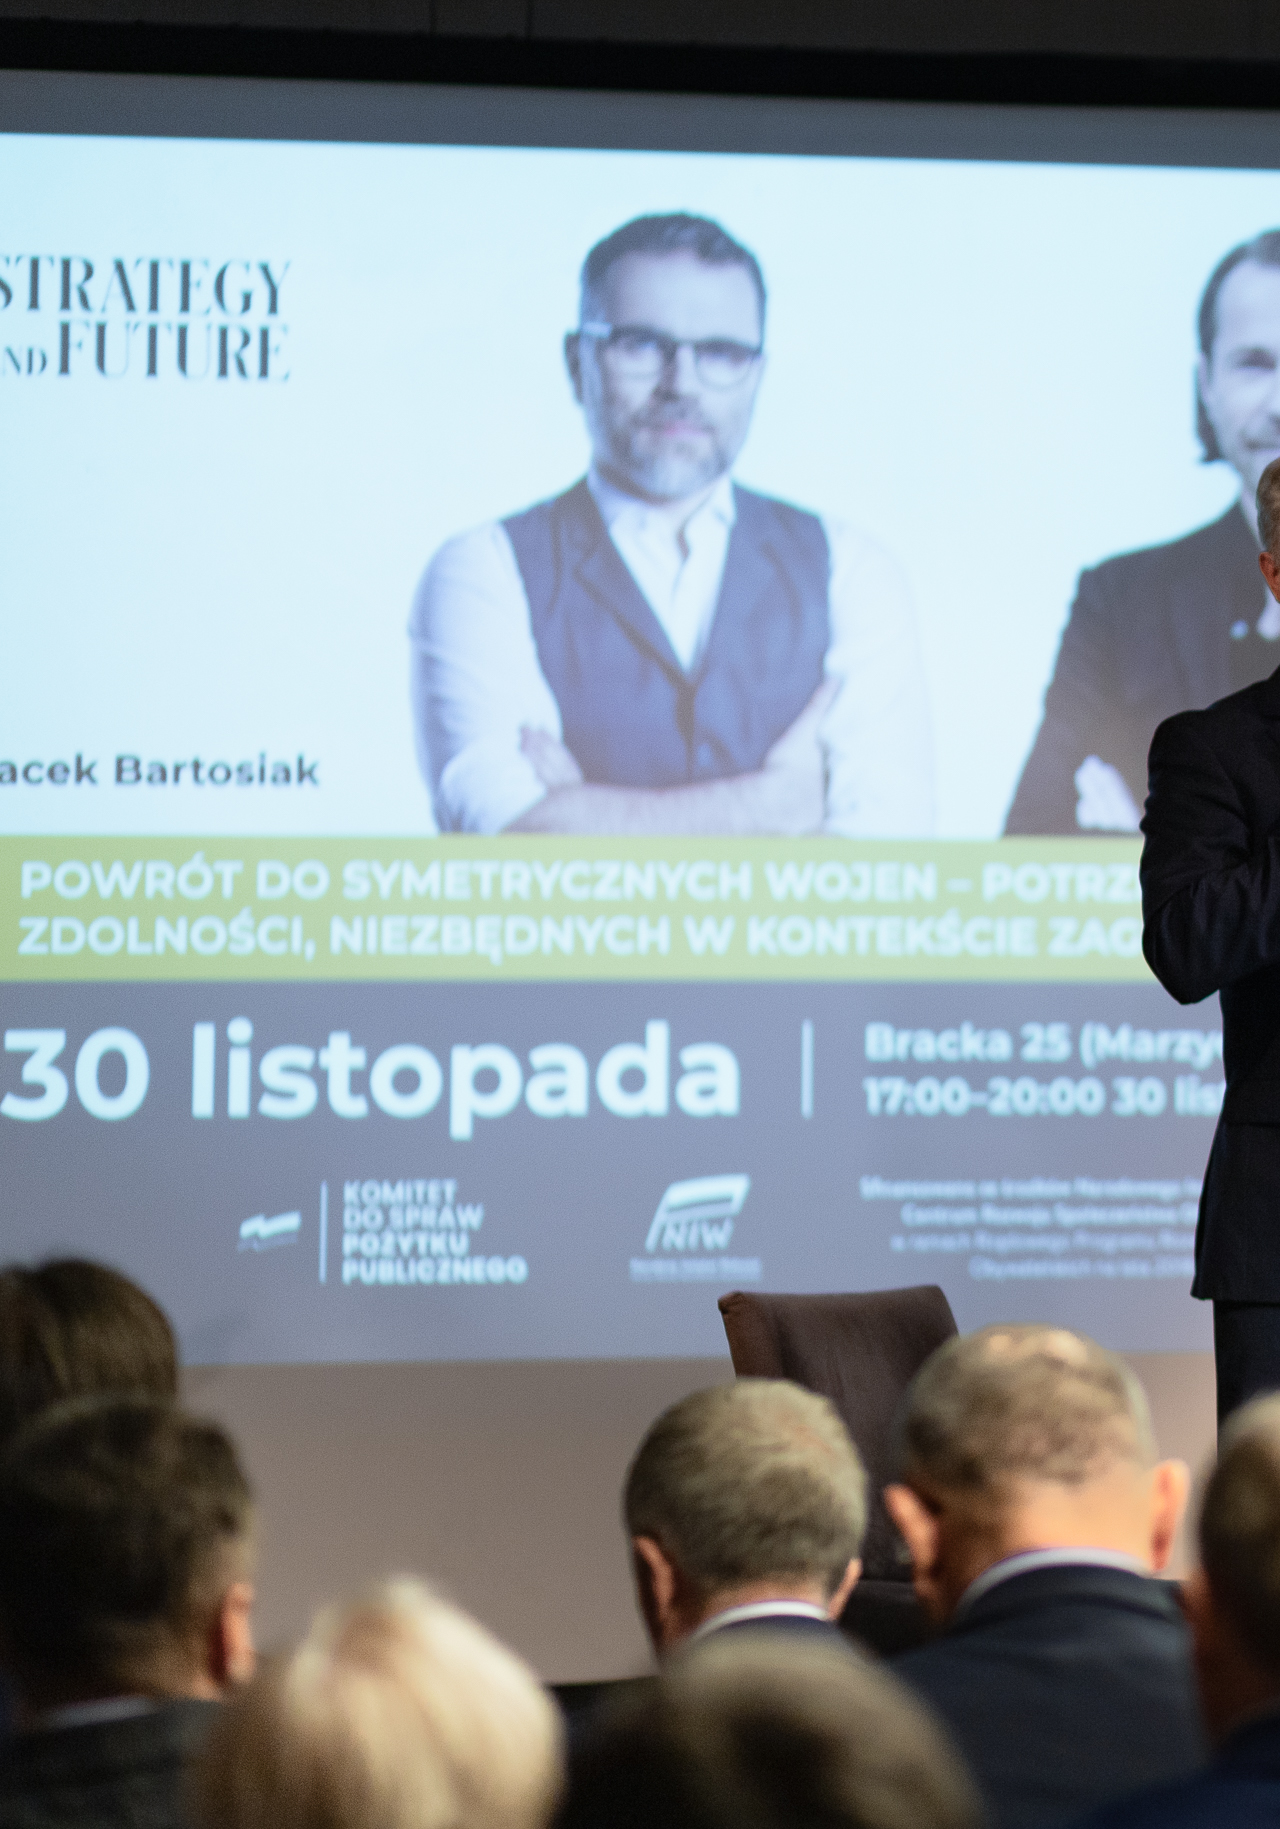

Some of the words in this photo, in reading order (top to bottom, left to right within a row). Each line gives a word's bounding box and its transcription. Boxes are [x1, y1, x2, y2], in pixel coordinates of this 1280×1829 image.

[0, 346, 48, 377] ND
[58, 320, 291, 381] FUTURE
[0, 751, 98, 786] acek
[114, 753, 321, 788] Bartosiak
[21, 850, 244, 900] POWRÓT
[256, 859, 330, 901] DO
[341, 859, 753, 902] SYMETRYCZNYCH
[764, 860, 938, 903] WOJEN
[982, 861, 1142, 903] POTRZ
[17, 906, 316, 962] ZDOLNOŚCI,
[330, 914, 672, 966] NIEZBĘDNYCH
[682, 914, 737, 957] W
[747, 907, 1037, 958] KONTEKŚCIE
[1047, 915, 1144, 958] ZAG
[864, 1020, 1014, 1063] Bracka
[1019, 1021, 1072, 1063] 25
[1, 1026, 151, 1121] 30
[190, 1017, 742, 1141] listopada
[1110, 1076, 1167, 1116] 30
[1173, 1073, 1226, 1117] lis
[342, 1179, 458, 1206] KOMITET
[342, 1205, 384, 1232] DO
[388, 1203, 485, 1231] SPRAW
[341, 1255, 530, 1286] PUBLICZNEGO
